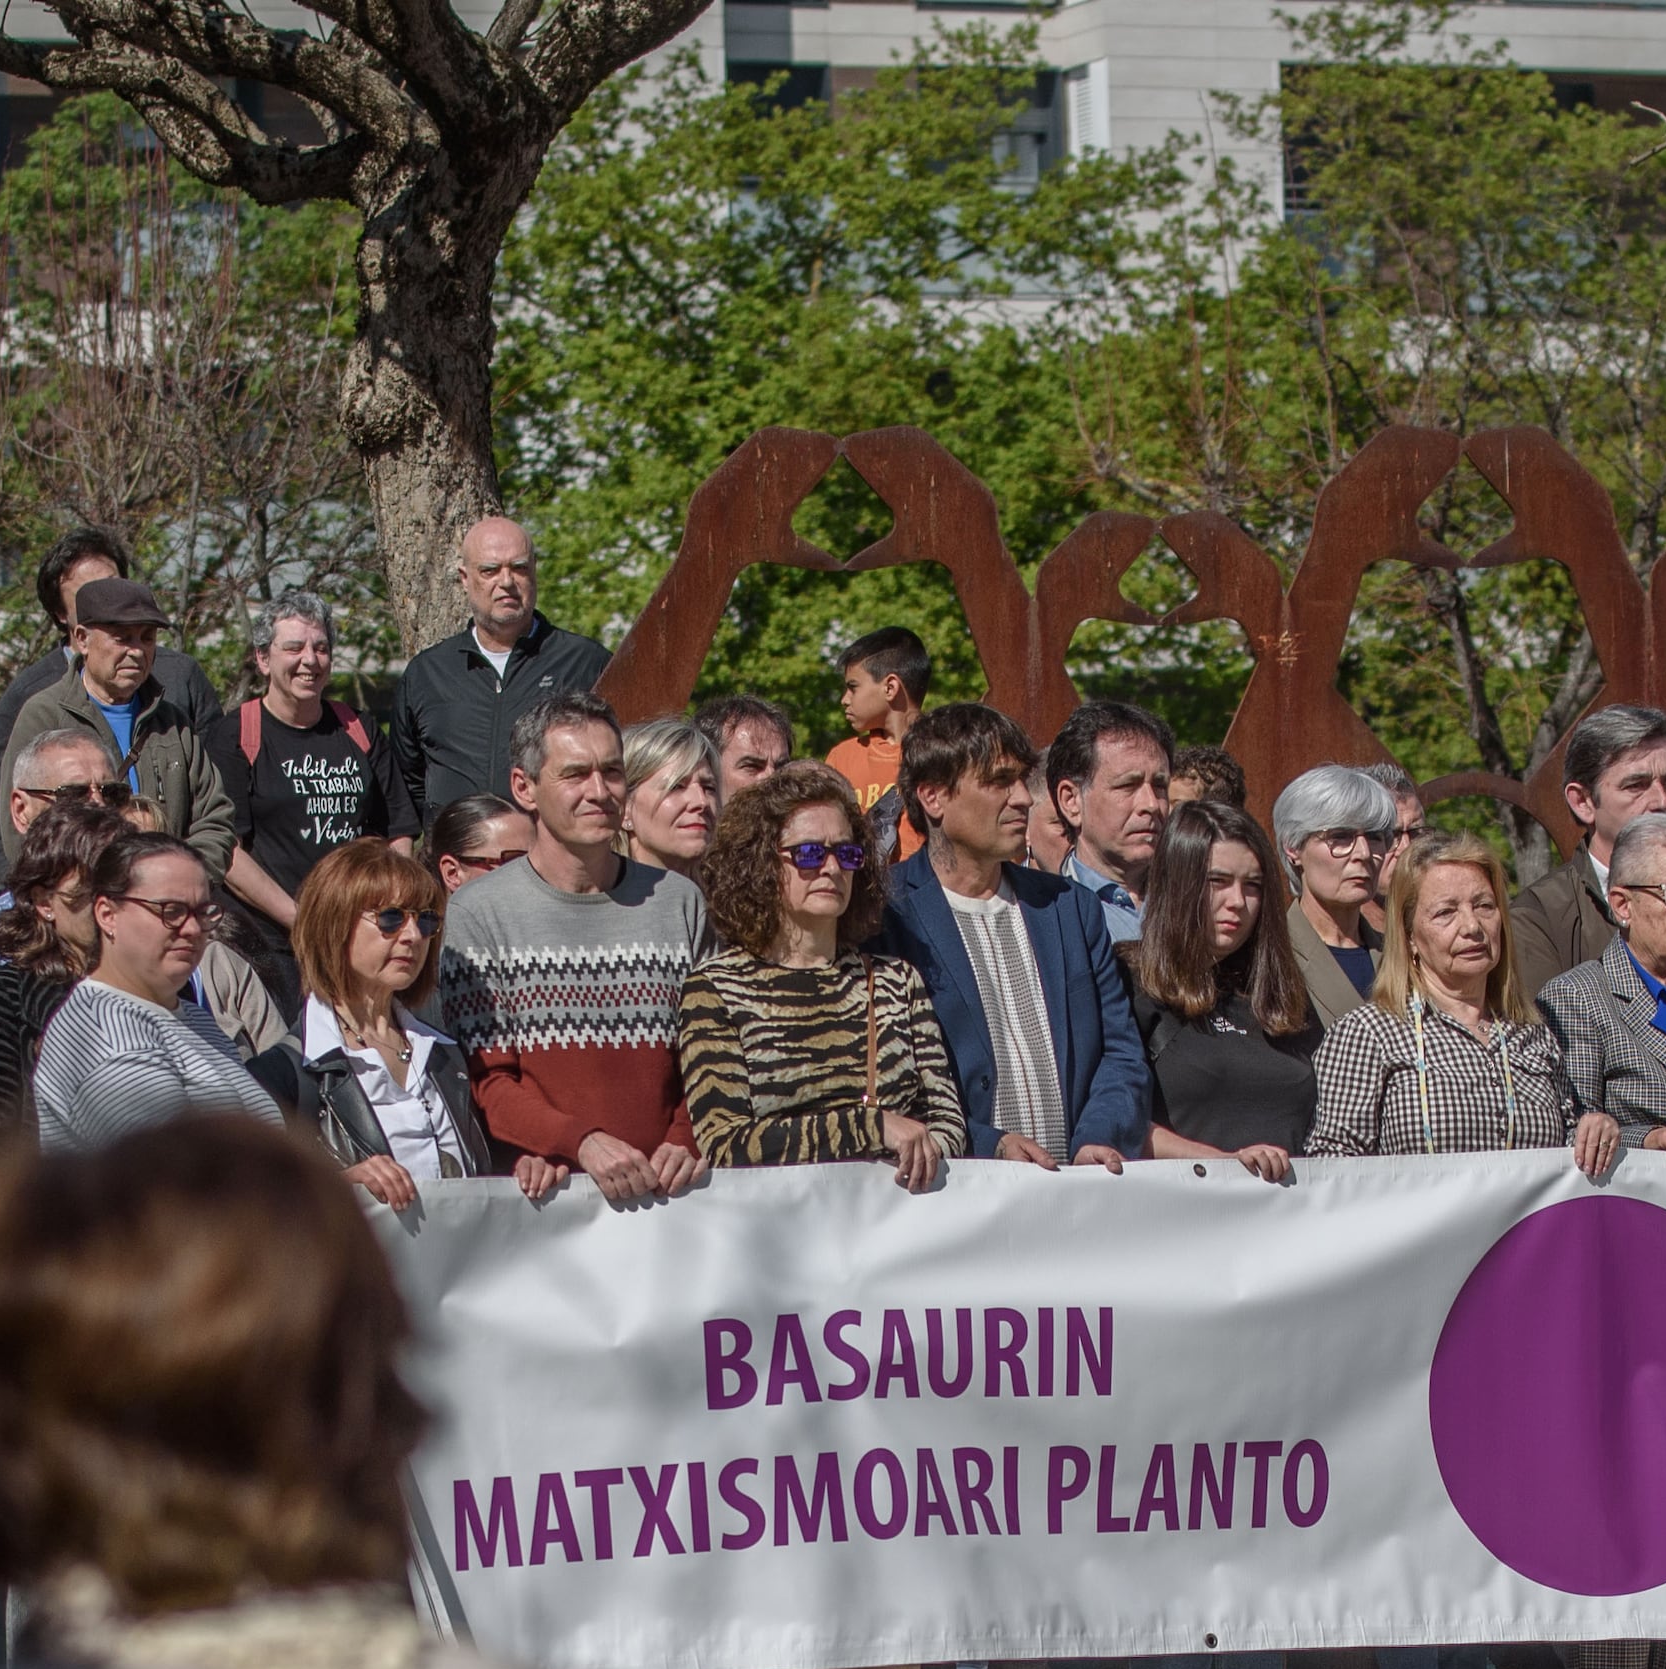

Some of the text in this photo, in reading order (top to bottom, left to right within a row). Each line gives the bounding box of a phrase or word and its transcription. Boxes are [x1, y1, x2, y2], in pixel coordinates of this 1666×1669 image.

[293, 776, 364, 795] EL TRABAJO
[306, 795, 358, 815] AHORA ES
[314, 815, 357, 845] Vivir
[703, 1307, 1114, 1410] BASAURIN
[453, 1438, 1330, 1572] MATXISMOARI PLANTO
